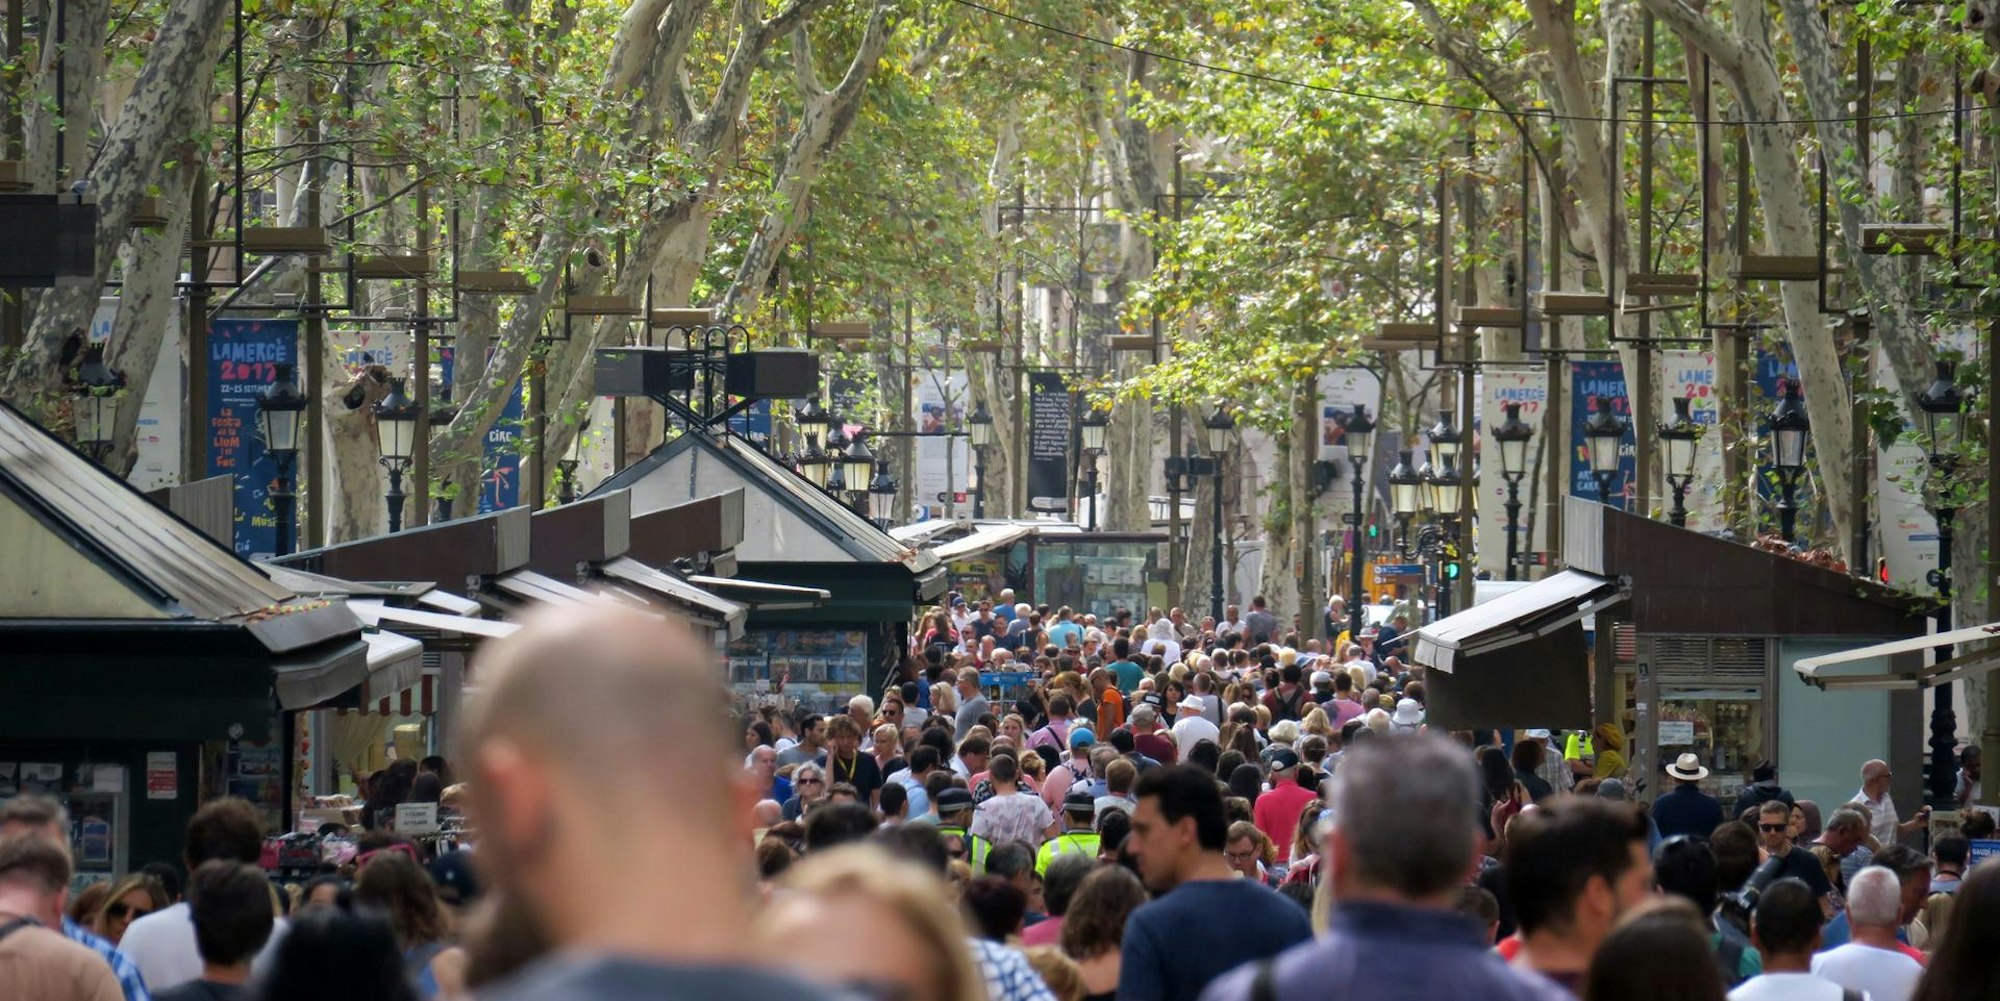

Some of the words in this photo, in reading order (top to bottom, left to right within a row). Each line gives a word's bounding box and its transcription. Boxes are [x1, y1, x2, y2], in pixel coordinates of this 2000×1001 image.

[220, 360, 276, 382] 2017
[1678, 369, 1714, 384] LAME
[1581, 380, 1627, 397] LAMER
[1685, 383, 1709, 398] 20
[1500, 400, 1539, 413] 217
